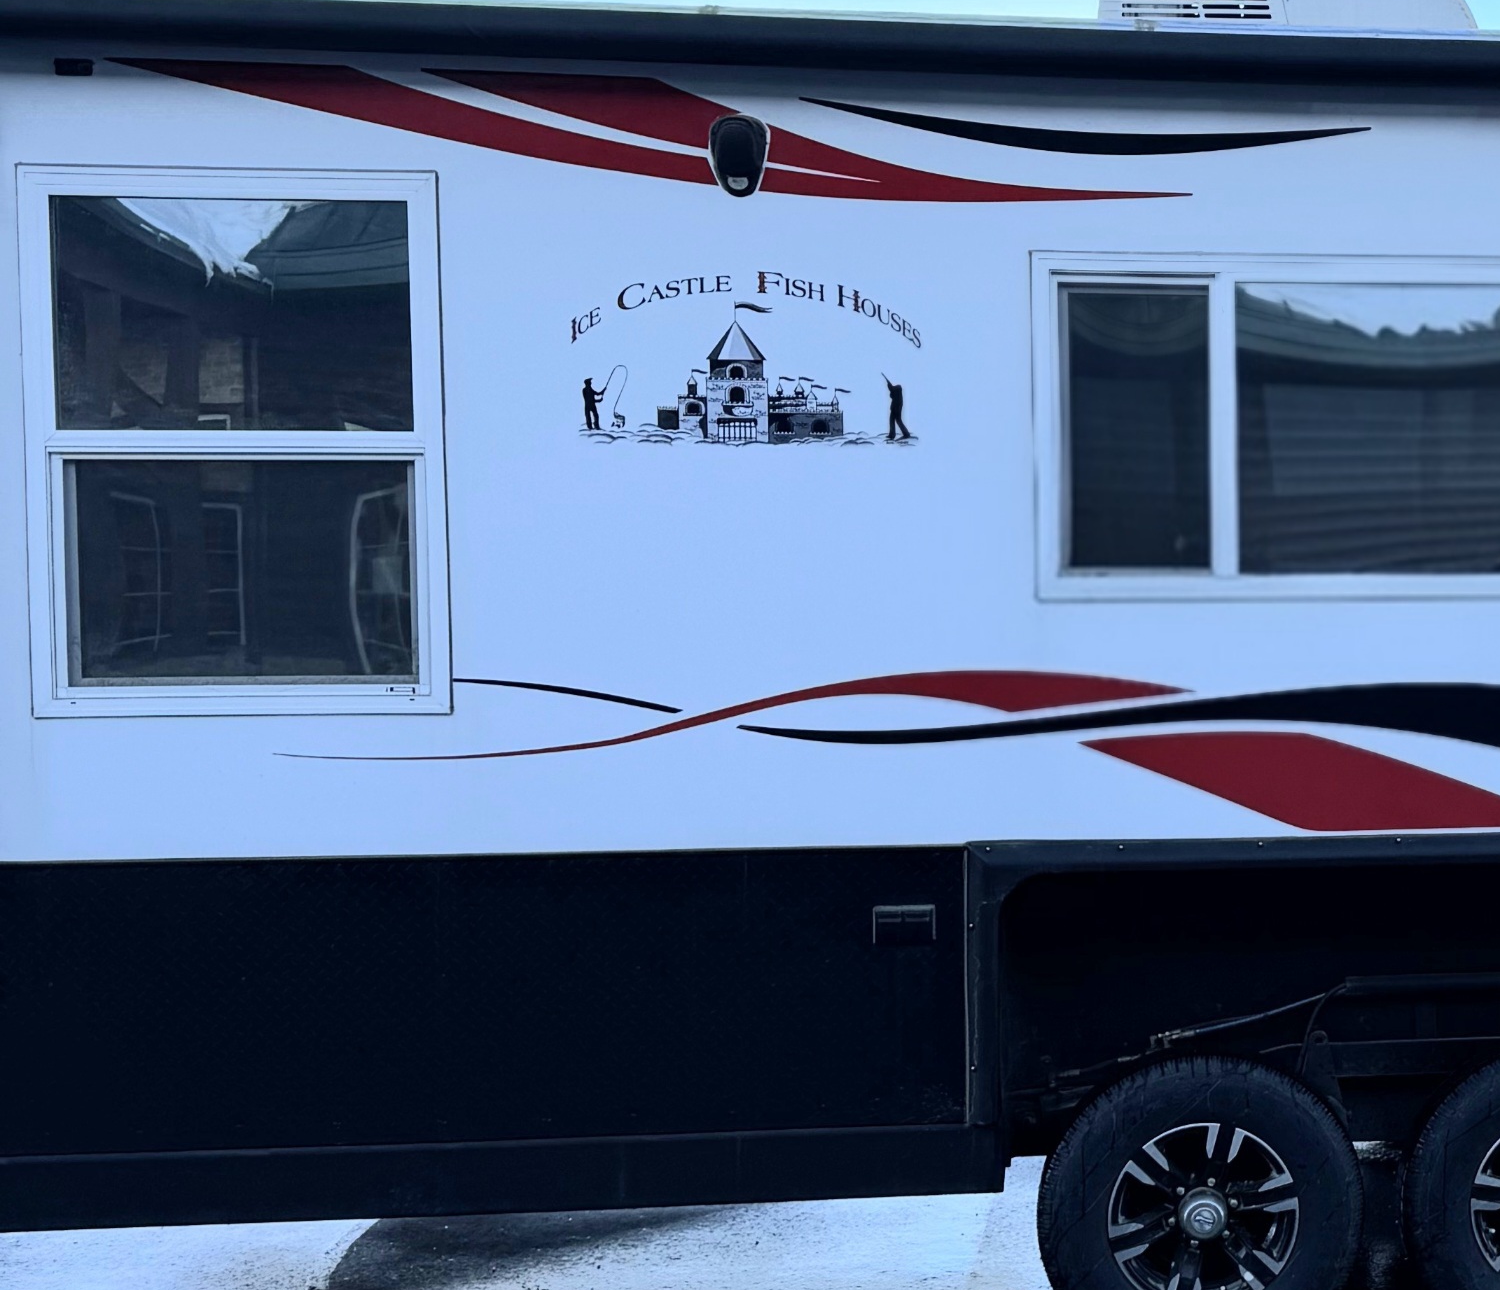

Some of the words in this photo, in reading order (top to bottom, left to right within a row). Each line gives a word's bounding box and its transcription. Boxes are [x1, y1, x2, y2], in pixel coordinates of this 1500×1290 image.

[570, 307, 602, 344] ICE
[616, 275, 733, 311] CASTLE
[757, 271, 825, 302] FISH
[837, 284, 922, 349] HOUSES
